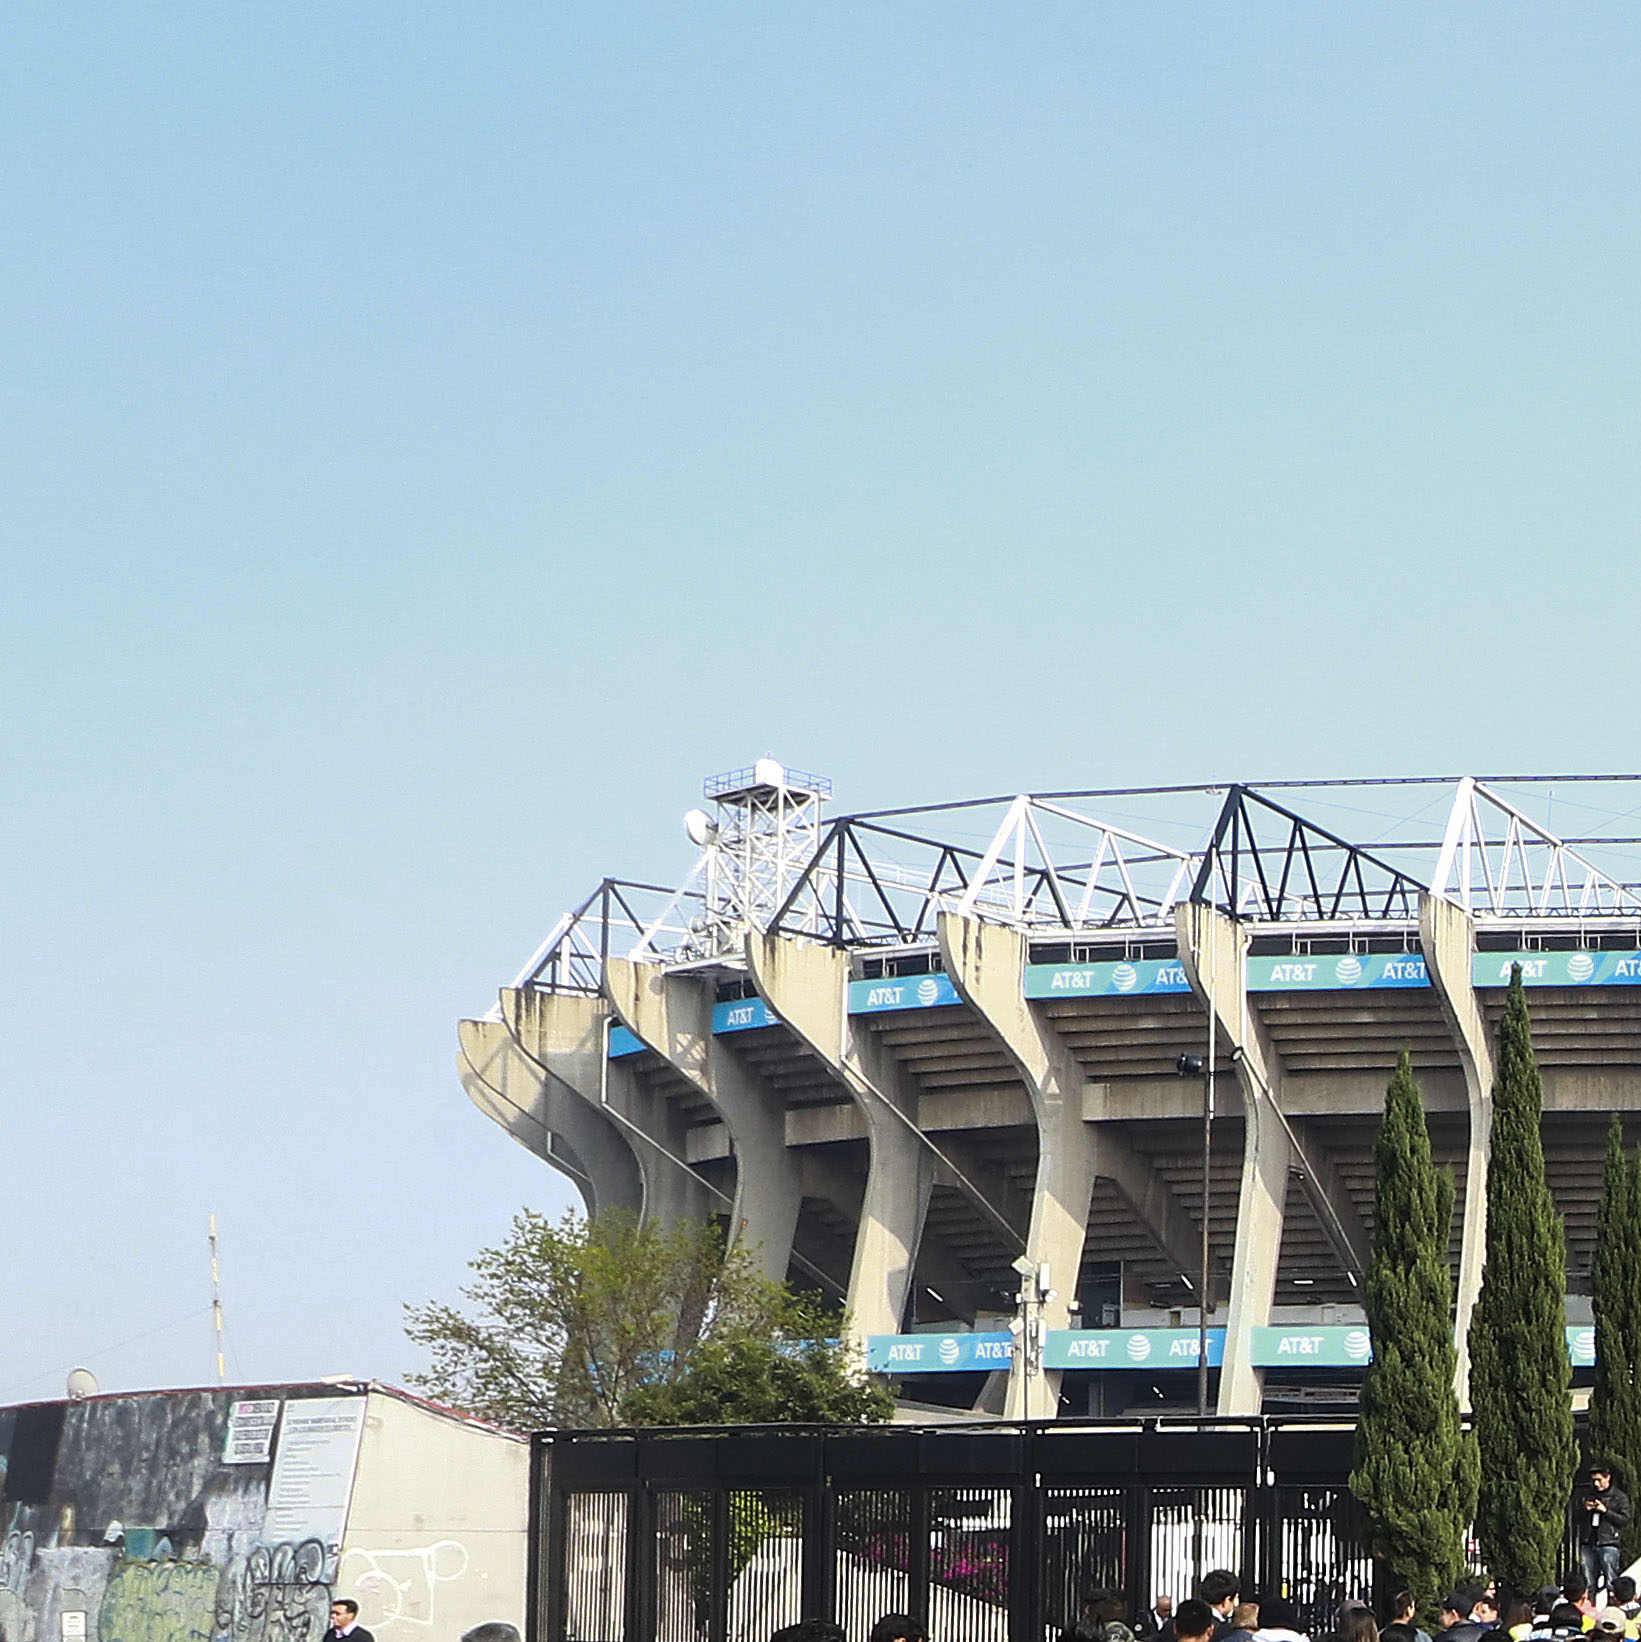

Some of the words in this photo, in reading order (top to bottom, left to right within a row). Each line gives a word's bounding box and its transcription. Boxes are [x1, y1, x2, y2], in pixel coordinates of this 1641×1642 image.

[1050, 970, 1097, 990] AT&T
[1269, 963, 1318, 982] AT&T
[867, 986, 904, 1007] AT&T
[727, 1007, 755, 1027] AT&T
[888, 1343, 925, 1361] AT&T
[1067, 1339, 1111, 1358] AT&T
[1276, 1336, 1325, 1356] AT&T
